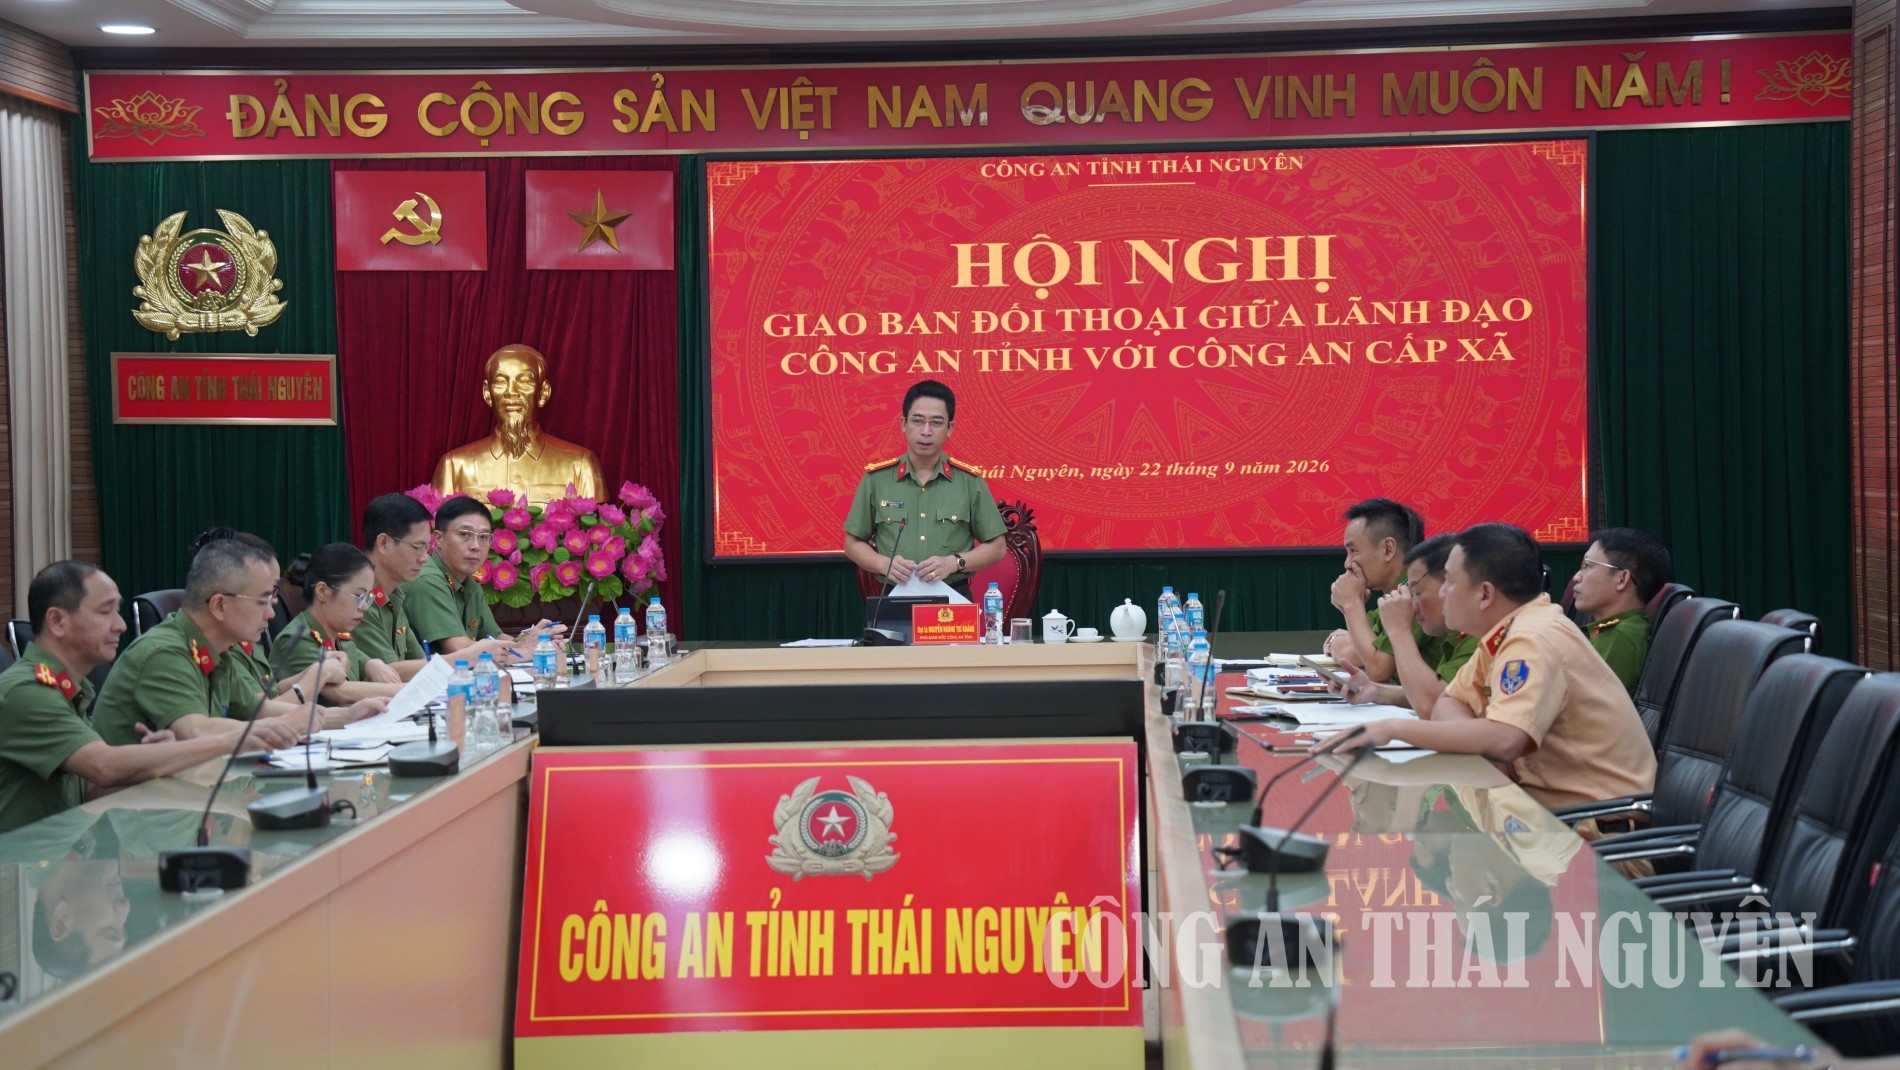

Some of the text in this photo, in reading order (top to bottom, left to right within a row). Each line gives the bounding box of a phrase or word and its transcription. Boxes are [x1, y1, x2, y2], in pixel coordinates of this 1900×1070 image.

[226, 51, 1731, 146] ĐẢNG CỘNG SẢN VIỆT NAM QUANG VINH MUÔN NĂM !
[980, 152, 1304, 178] CÔNG AN TỈNH THÁI NGUYÊN
[950, 233, 1337, 300] HỘI NGHỊ
[763, 296, 1533, 338] GIAO BAN ĐỐI THOẠI GIỮA LÃNH ĐẠO
[780, 331, 1515, 376] CÔNG AN TỈNH VỚI CÔNG AN CẤP XÃ
[128, 368, 323, 402] CÔNG AN TỈNH THÁI NGUYÊN
[1009, 463, 1085, 482] Nguyên,
[1090, 463, 1134, 481] ngày
[1139, 462, 1161, 477] 22
[1166, 462, 1219, 480] tháng
[1224, 462, 1236, 475] 9
[1240, 460, 1281, 475] năm
[1285, 459, 1331, 475] 2026
[560, 887, 1102, 982] CÔNG AN TỈNH THÁI NGUYÊN
